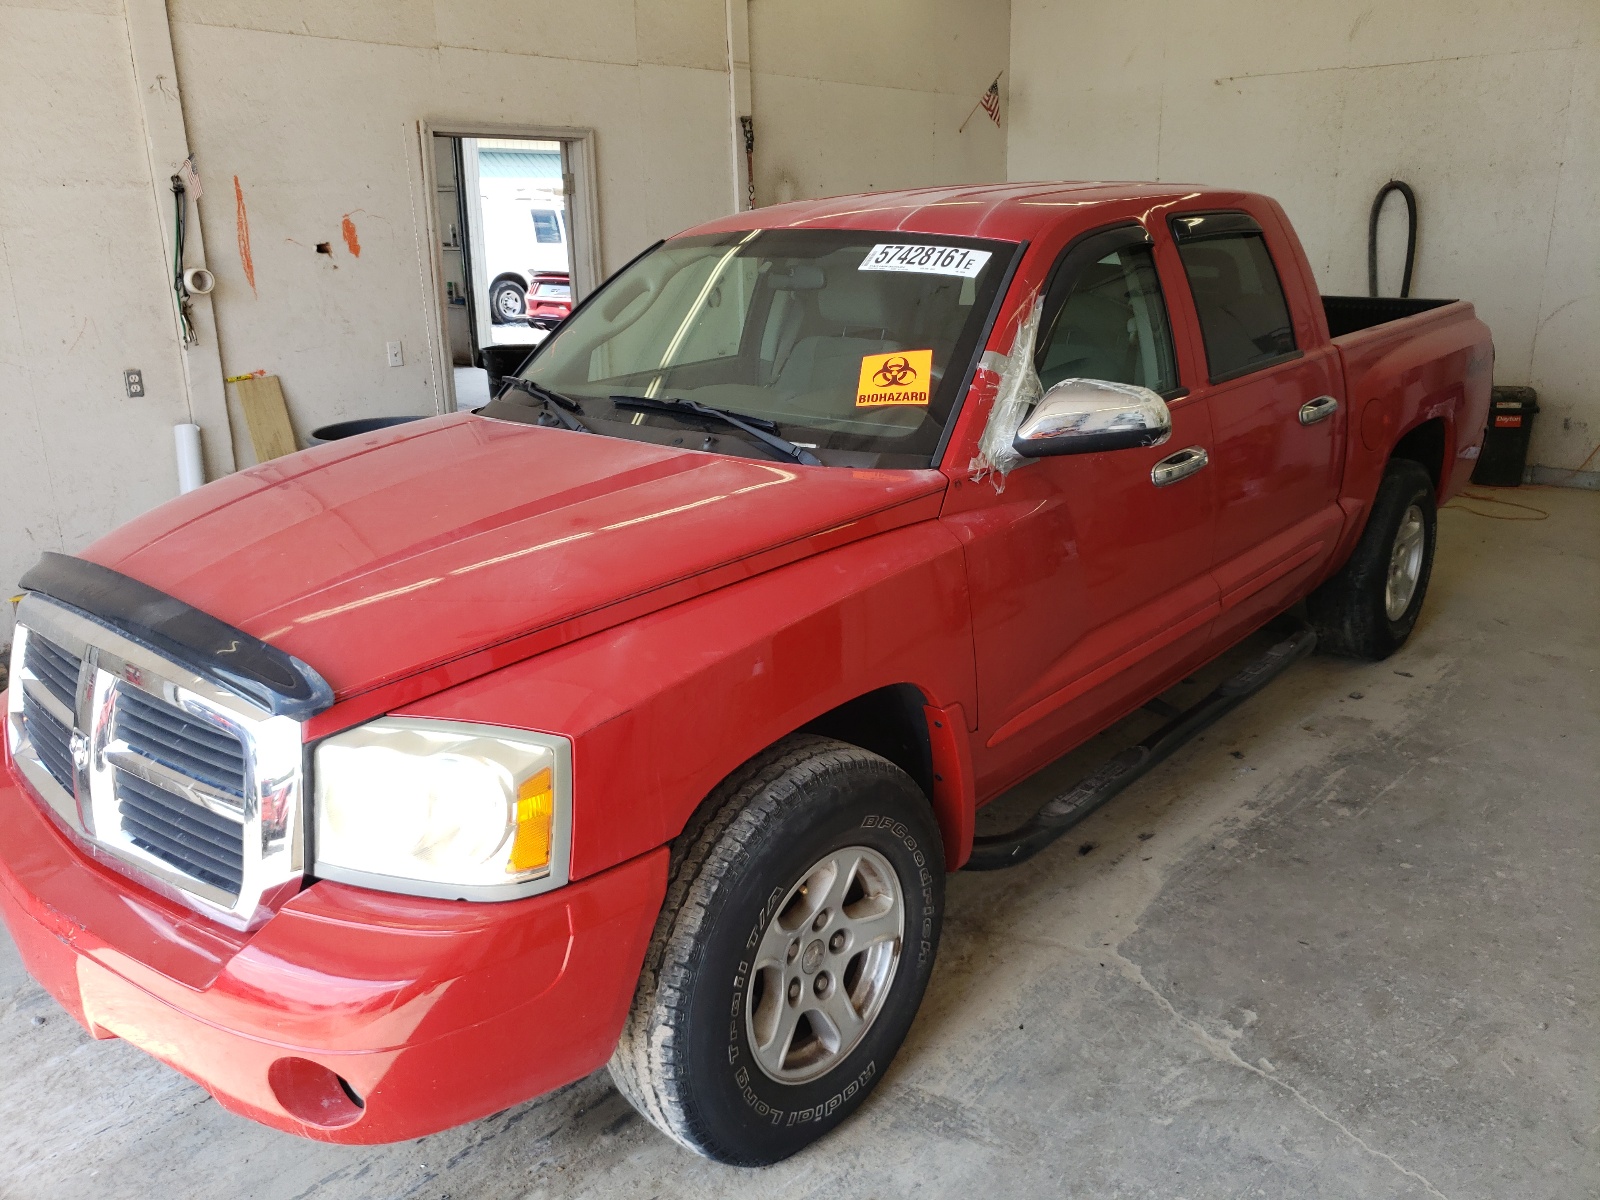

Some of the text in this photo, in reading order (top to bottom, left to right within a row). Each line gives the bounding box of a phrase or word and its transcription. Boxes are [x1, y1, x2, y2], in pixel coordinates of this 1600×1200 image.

[858, 392, 927, 403] BIOHAZARD
[1496, 415, 1521, 423] Dayton
[861, 815, 934, 967] BFGoodrich
[728, 886, 876, 1127] Radial Long Trail T/A
